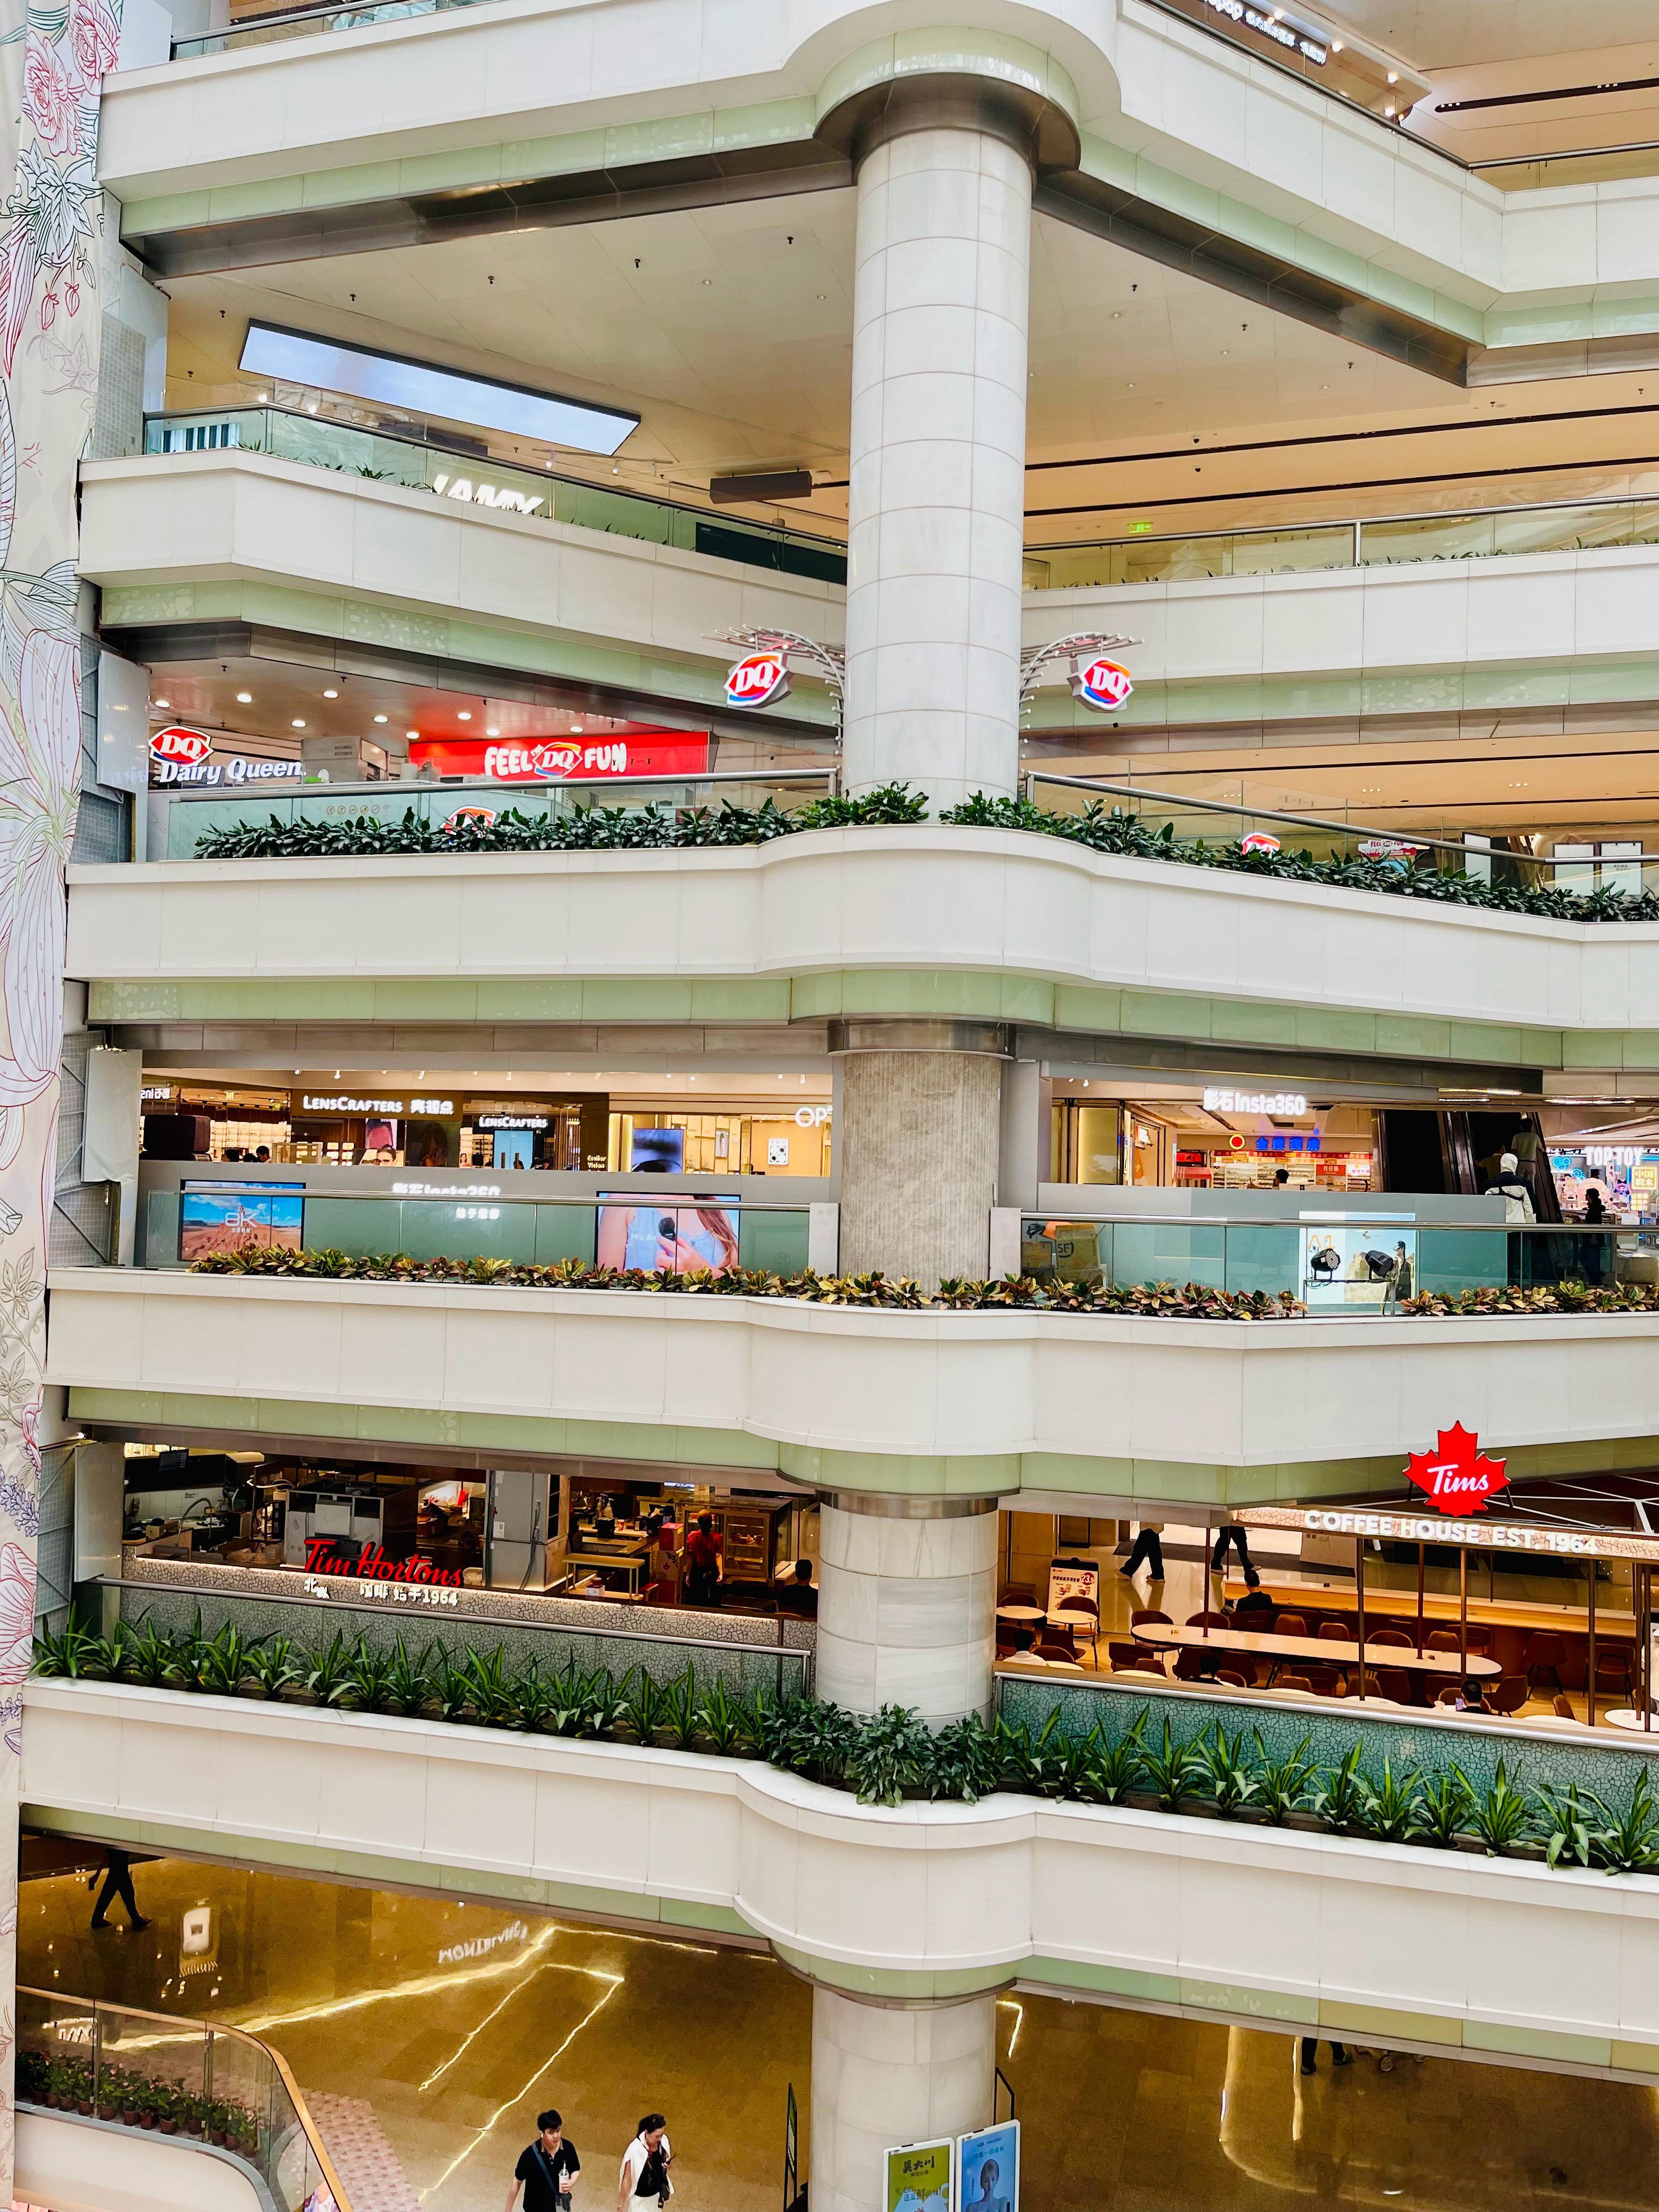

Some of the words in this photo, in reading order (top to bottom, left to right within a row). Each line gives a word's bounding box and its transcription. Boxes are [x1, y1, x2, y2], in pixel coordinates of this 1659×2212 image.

[735, 661, 774, 693] DQ
[1090, 665, 1126, 699] DQ
[160, 734, 202, 760] DQ
[484, 747, 533, 776] FEEL
[541, 750, 574, 770] DQ
[584, 742, 627, 772] FUN
[160, 762, 222, 785] Dairy
[1585, 1147, 1612, 1166] TOP
[1615, 1147, 1643, 1166] TOY
[225, 1211, 258, 1228] 8K
[1427, 1464, 1488, 1494] Tims
[1304, 1510, 1392, 1535] COFFEE
[1401, 1519, 1481, 1544] HOUSE
[1492, 1526, 1541, 1550] EST.
[1545, 1532, 1598, 1554] 1964
[304, 1539, 351, 1576] Tim
[357, 1542, 462, 1587] Hortons
